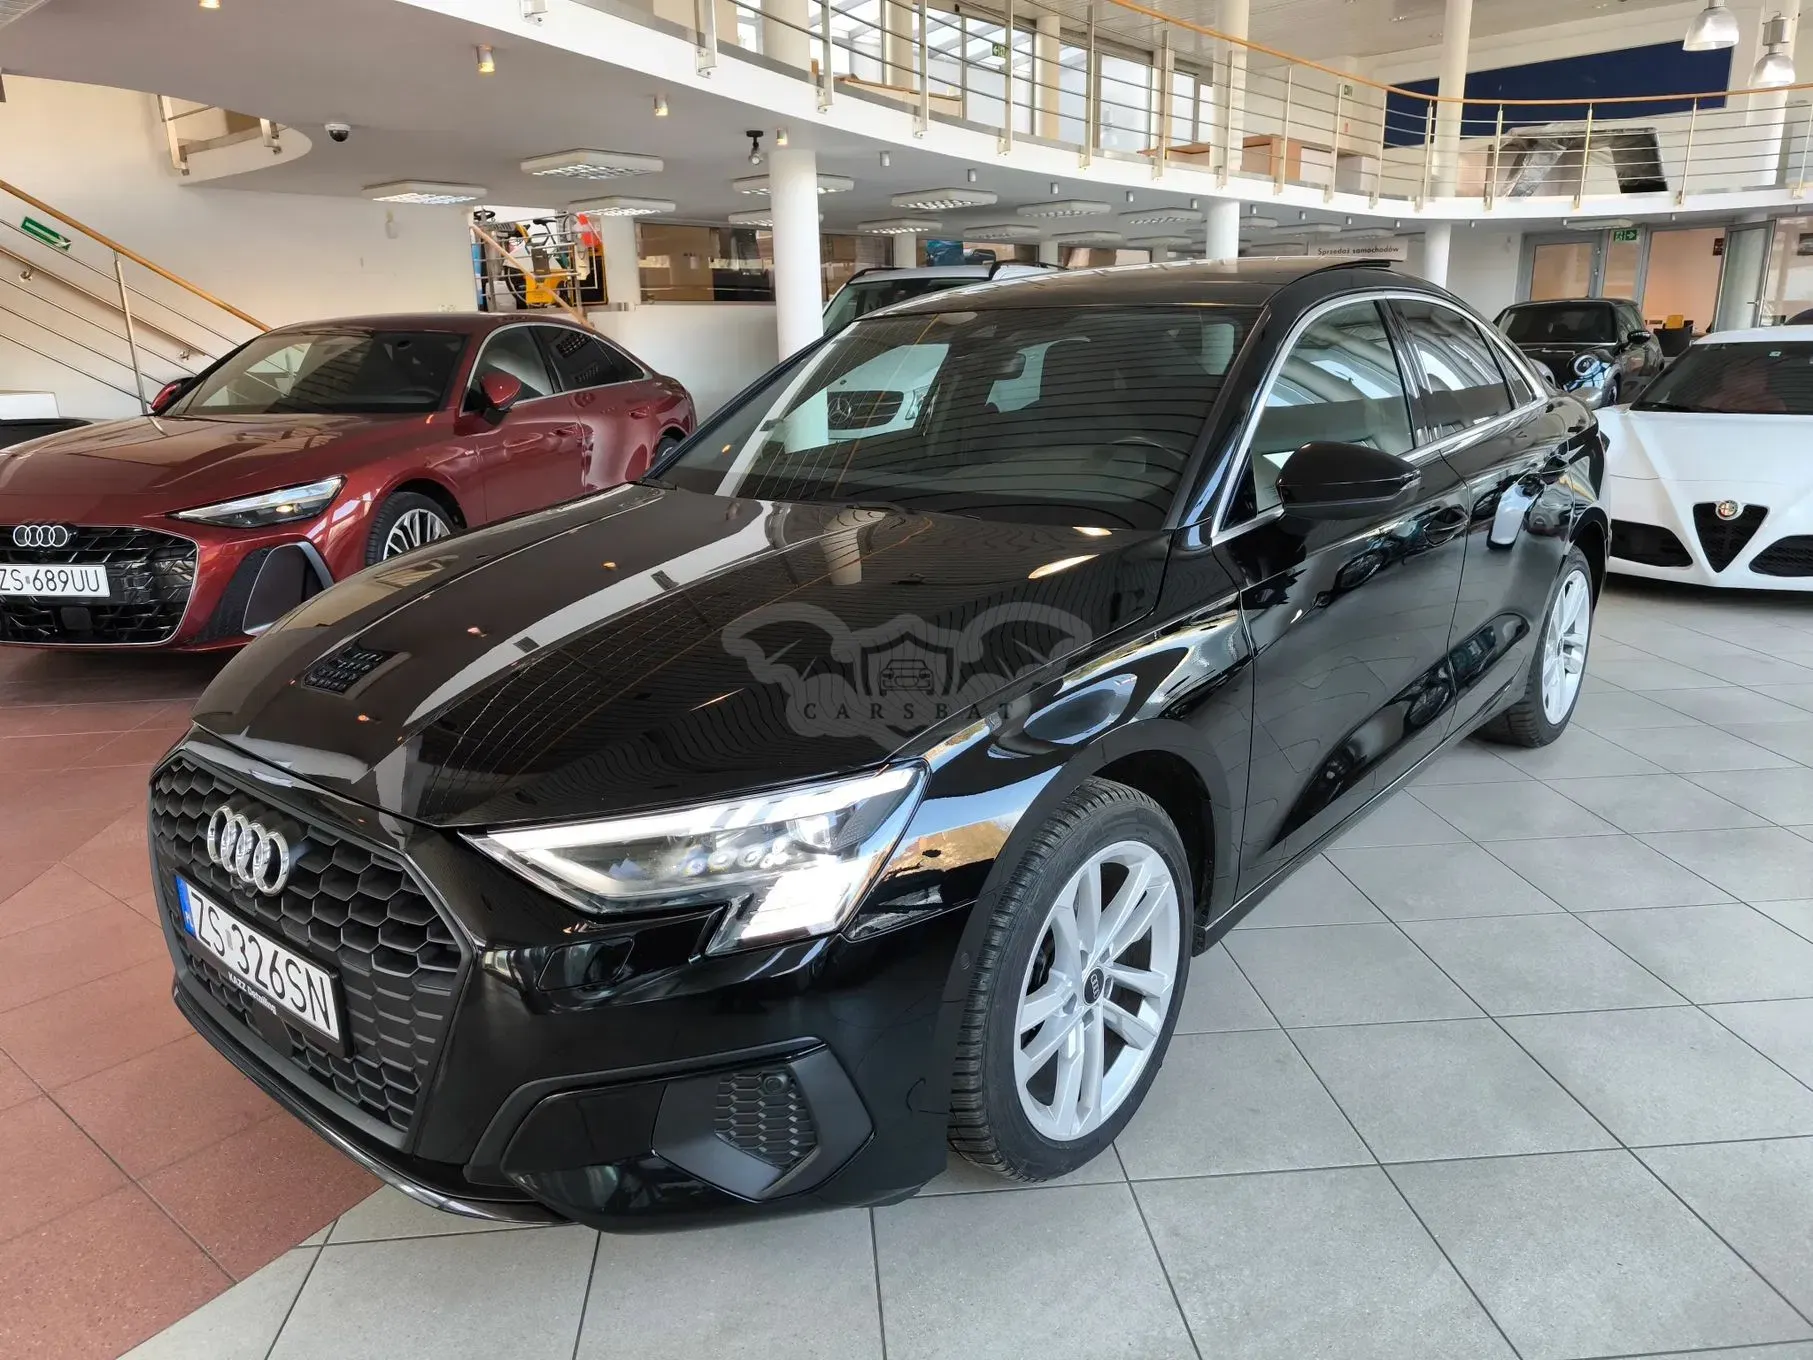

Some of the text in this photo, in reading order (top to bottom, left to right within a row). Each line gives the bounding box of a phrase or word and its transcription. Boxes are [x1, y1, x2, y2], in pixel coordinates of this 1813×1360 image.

[0, 568, 100, 592] ZS 689UU
[191, 891, 331, 1031] ZS 326SN
